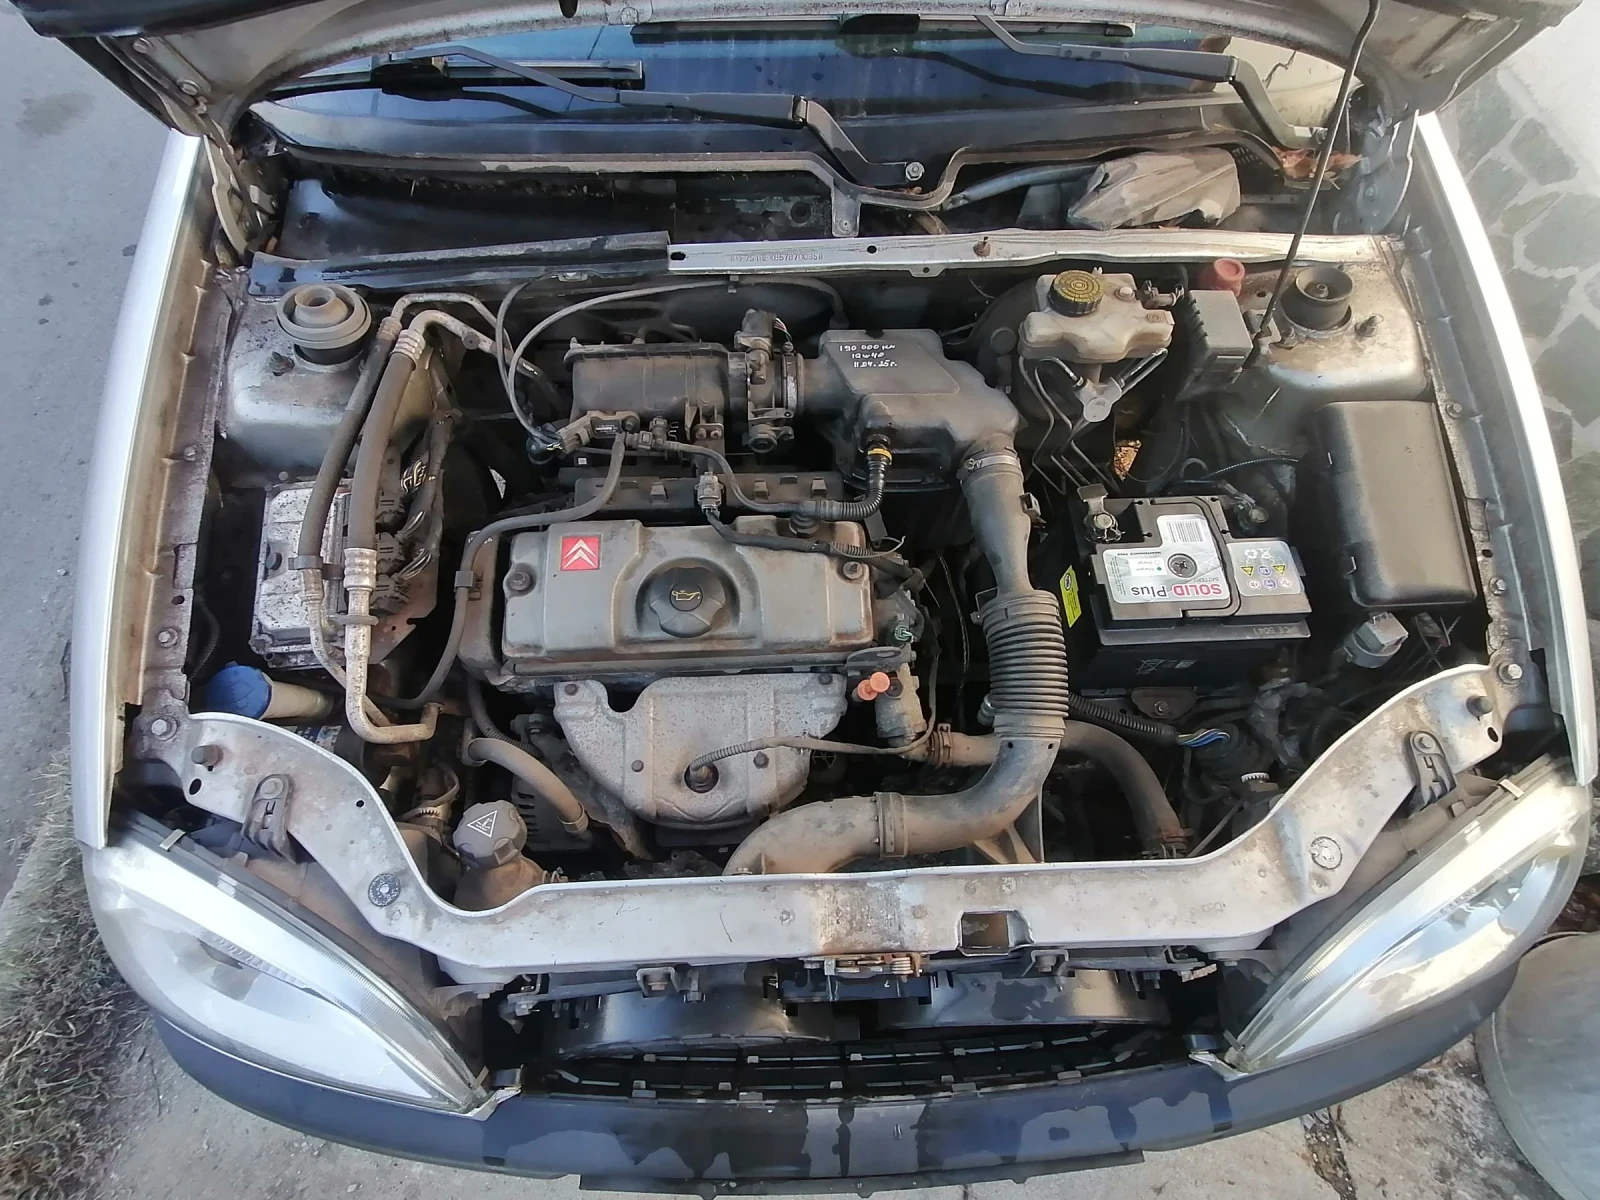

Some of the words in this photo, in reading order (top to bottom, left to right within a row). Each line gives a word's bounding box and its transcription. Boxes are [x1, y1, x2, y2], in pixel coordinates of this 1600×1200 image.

[839, 344, 857, 352] 190
[1131, 585, 1167, 598] Plus
[1173, 583, 1222, 596] SOLID
